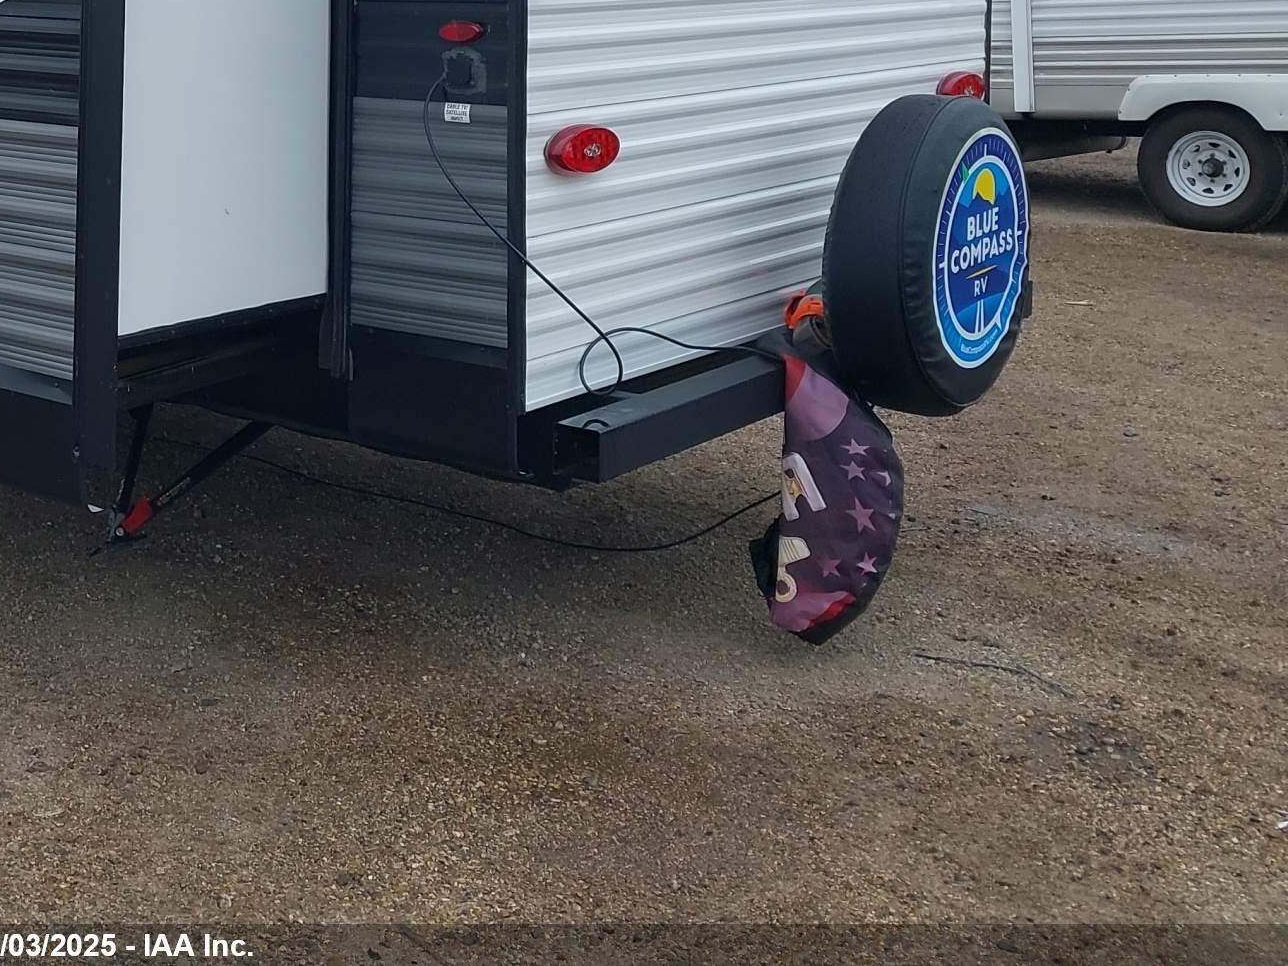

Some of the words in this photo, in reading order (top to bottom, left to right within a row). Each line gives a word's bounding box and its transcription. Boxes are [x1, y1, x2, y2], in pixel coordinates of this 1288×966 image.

[967, 206, 1000, 241] BLUE
[951, 228, 1013, 274] COMPASS
[974, 275, 988, 297] RV
